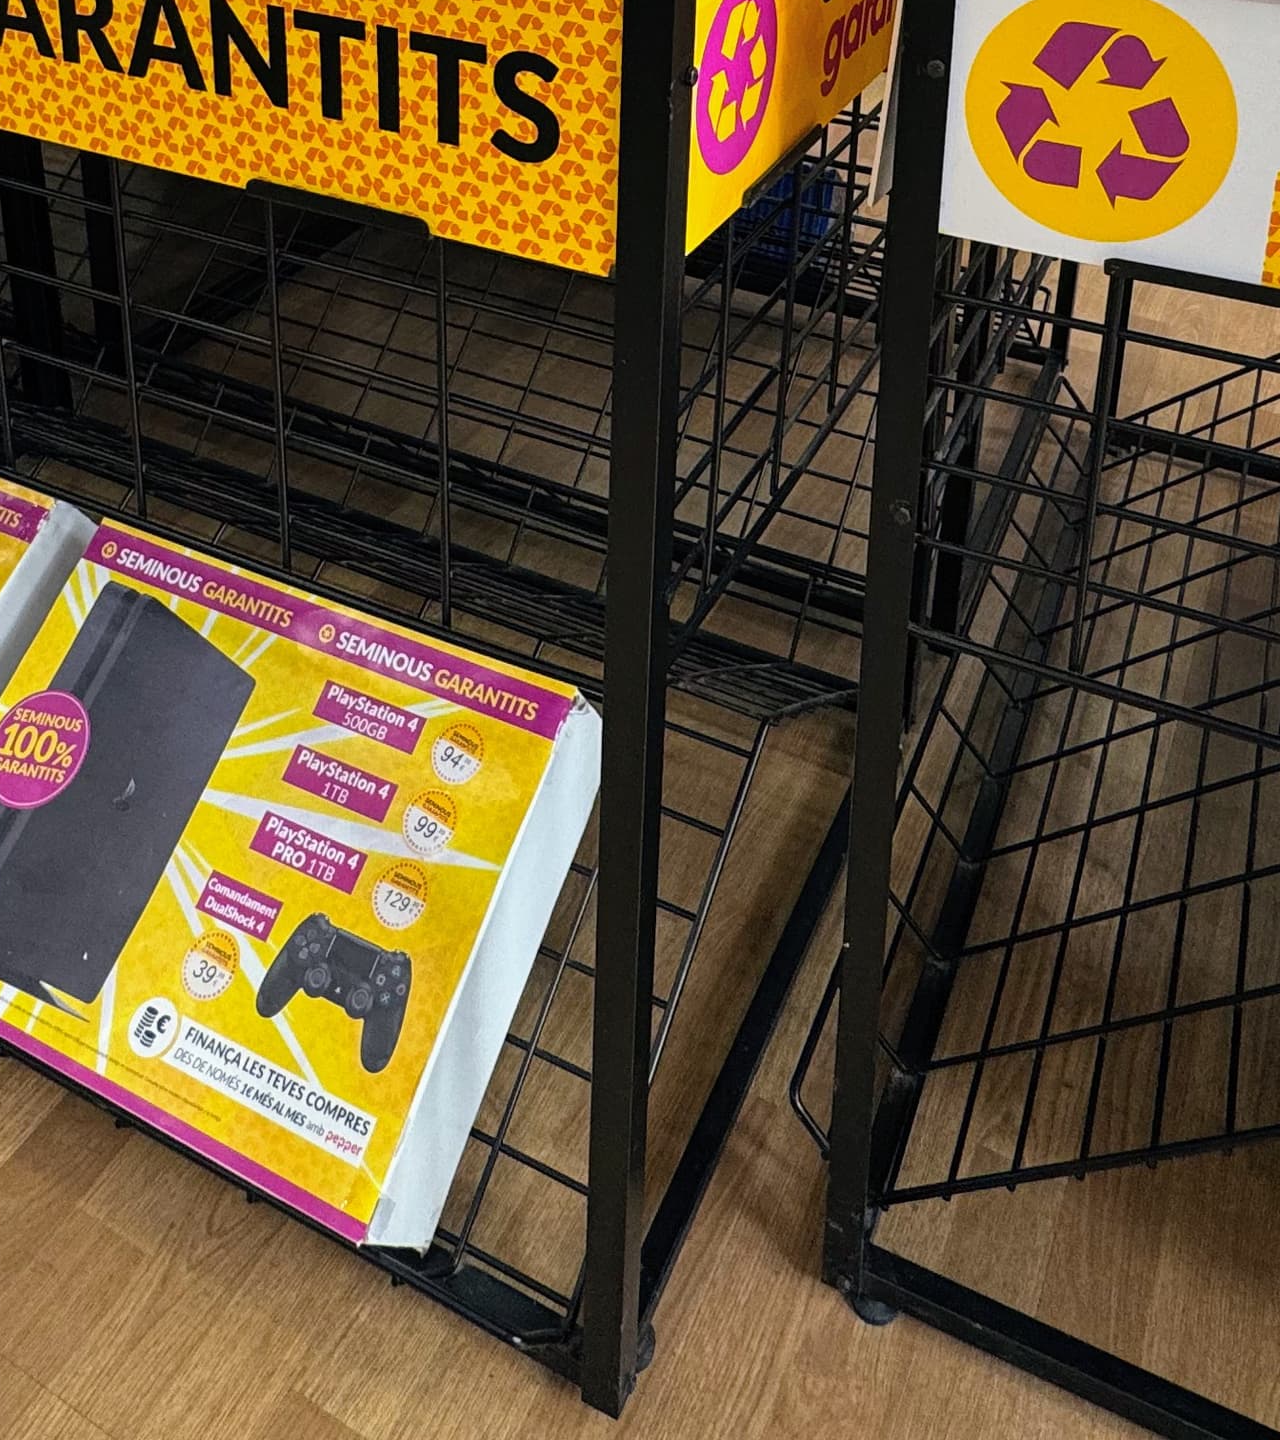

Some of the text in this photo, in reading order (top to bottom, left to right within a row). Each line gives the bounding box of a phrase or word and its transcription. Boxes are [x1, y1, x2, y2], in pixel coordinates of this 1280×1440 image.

[115, 547, 540, 722] SEMINOUS GARANTITS SEMINOUS GARANTITS
[12, 706, 84, 735] SEMINOUS
[327, 685, 419, 732] PlayStation 4
[341, 712, 389, 741] 500GB
[297, 749, 391, 799] PlayStation 4
[322, 783, 350, 805] 1TB
[266, 816, 360, 870] PlayStation 4
[271, 843, 336, 883] PRO 1TB
[204, 895, 265, 934] DualShock 4
[208, 877, 277, 920] Comandament
[174, 1047, 363, 1156] DES DE NOMÉS 1€ MÉS AL MES amb pepper
[185, 1026, 371, 1137] FINANÇA LES TEVES COMPRES
